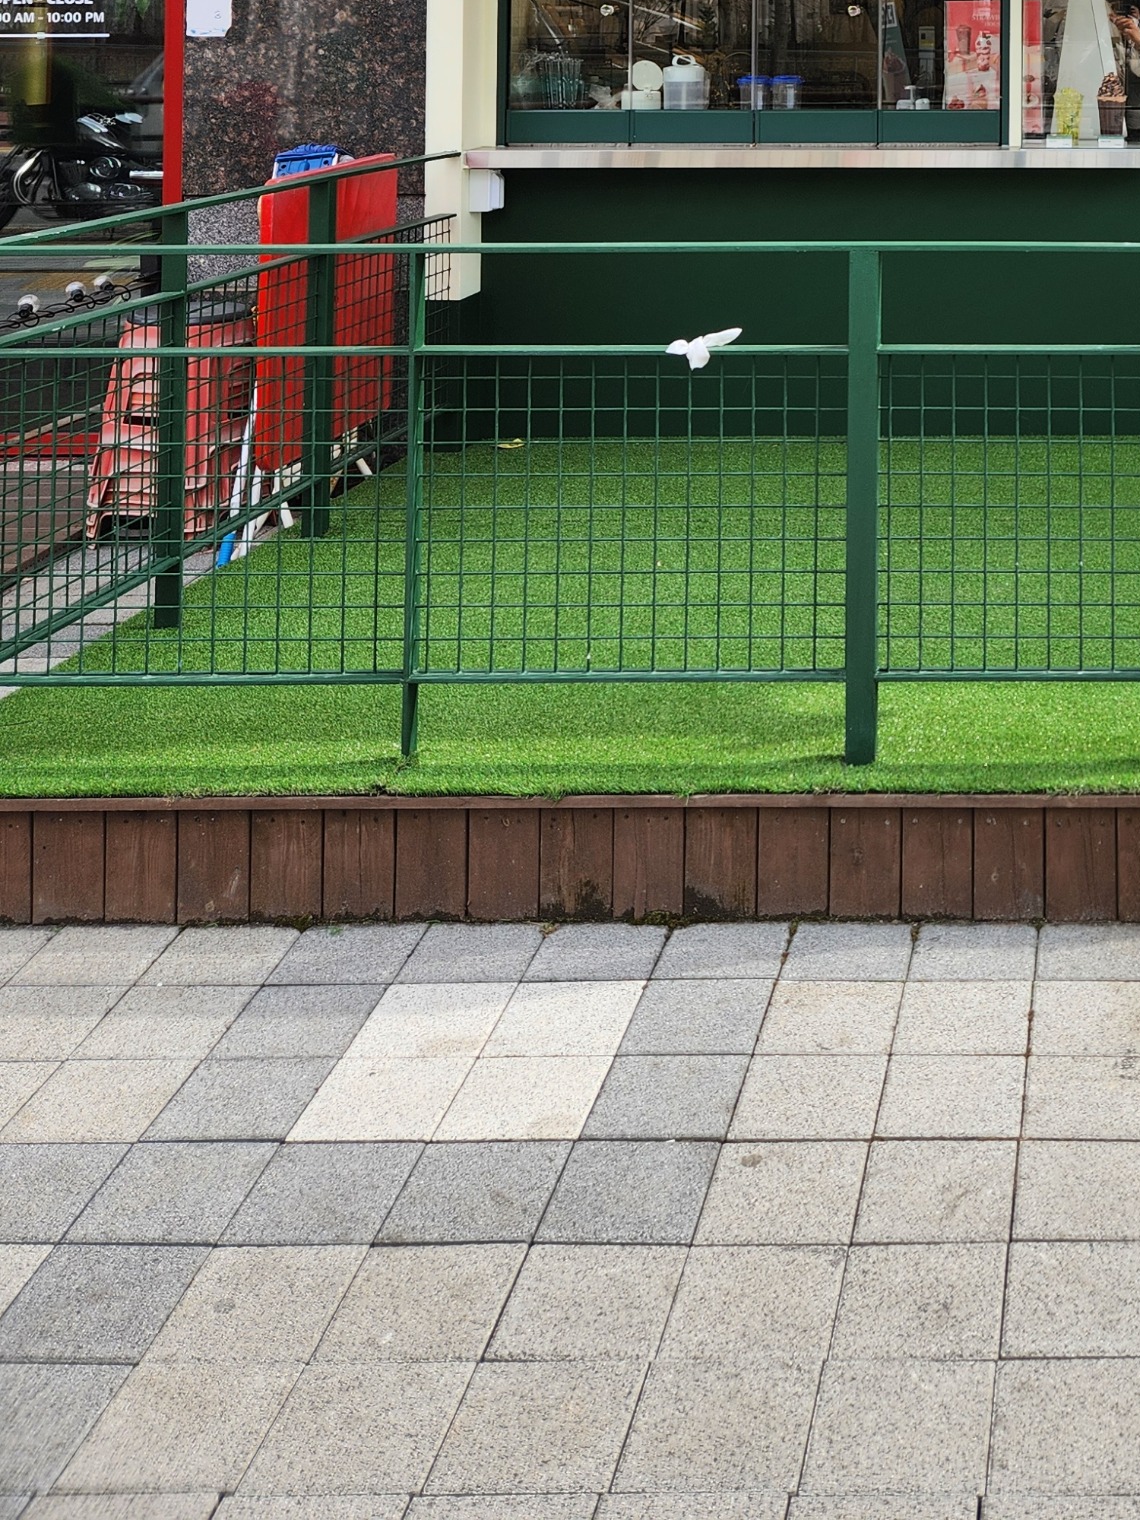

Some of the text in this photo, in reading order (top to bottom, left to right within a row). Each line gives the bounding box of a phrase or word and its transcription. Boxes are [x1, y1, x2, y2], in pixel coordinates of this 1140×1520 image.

[14, 12, 35, 23] AM
[47, 12, 82, 23] 10:00
[85, 12, 105, 23] PM
